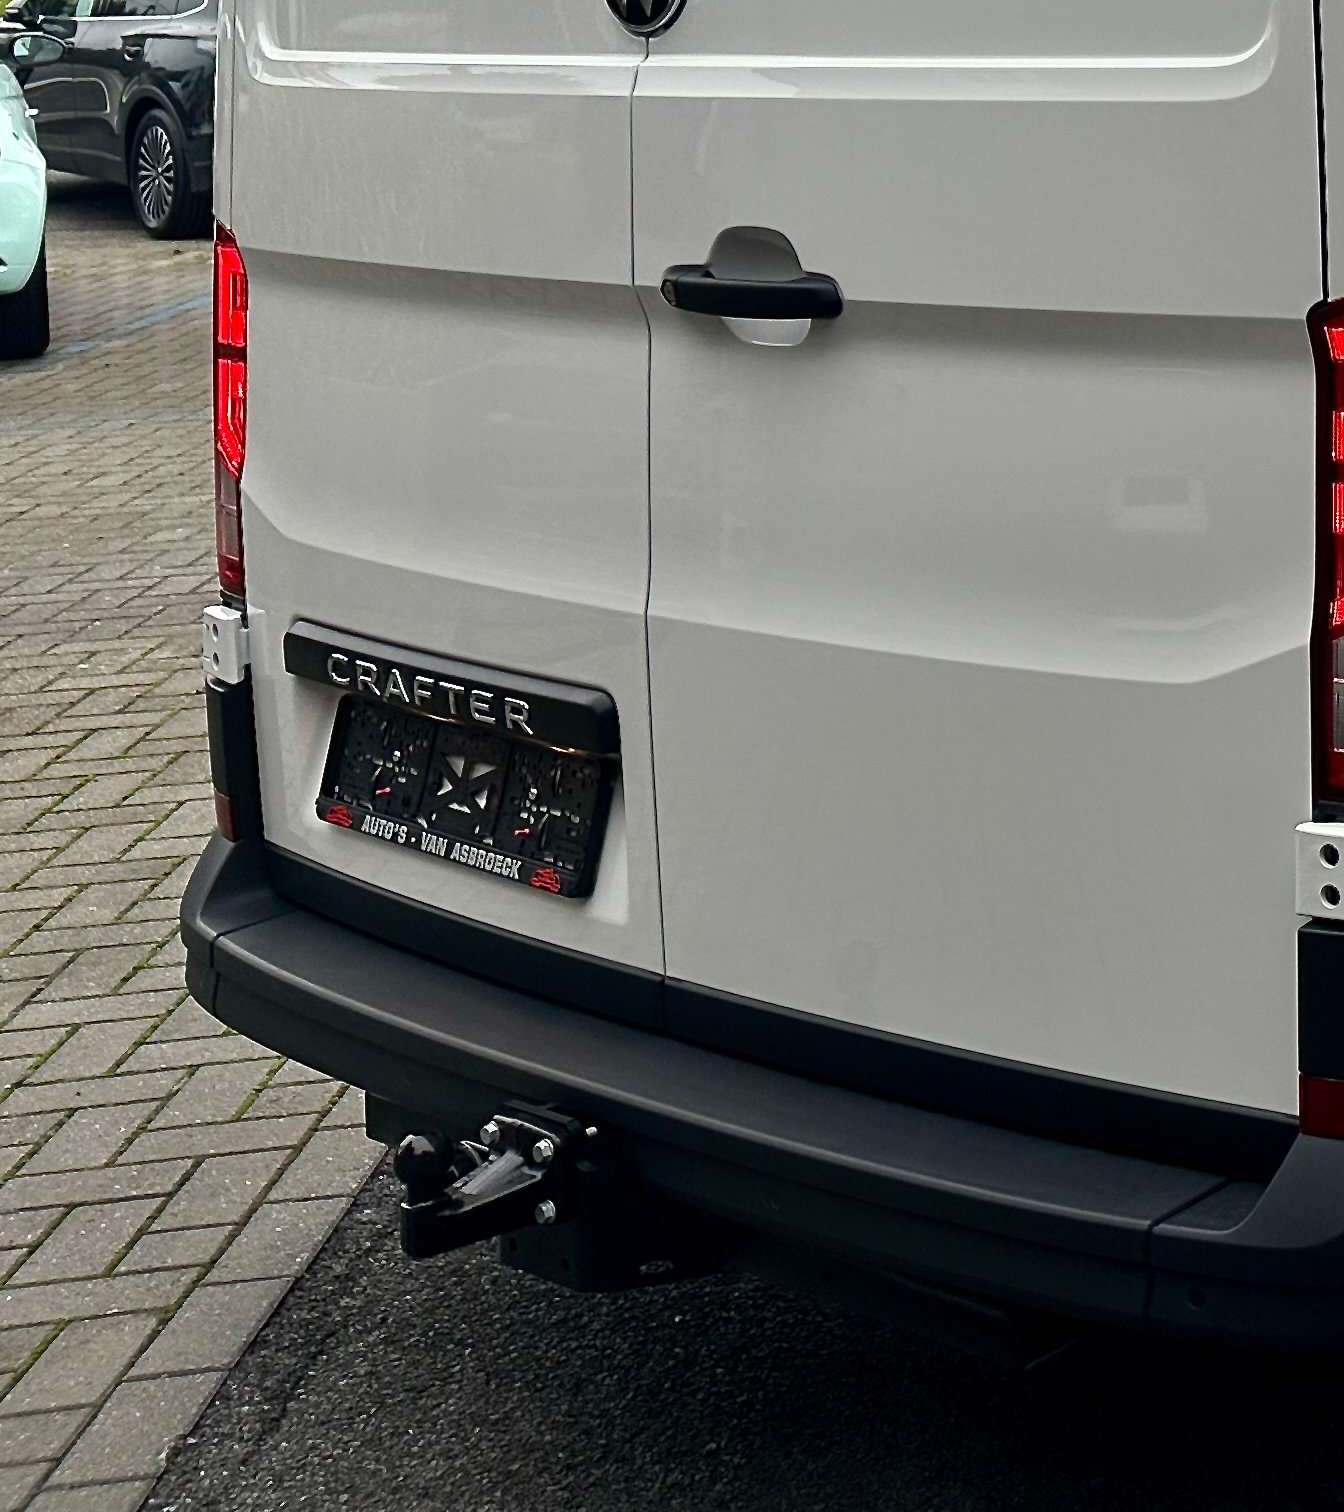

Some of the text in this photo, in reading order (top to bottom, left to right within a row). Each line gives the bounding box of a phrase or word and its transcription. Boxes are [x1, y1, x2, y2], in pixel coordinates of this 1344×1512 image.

[327, 653, 534, 735] CRAFTER
[361, 815, 522, 880] AUTO'S VAN ASBROECK
